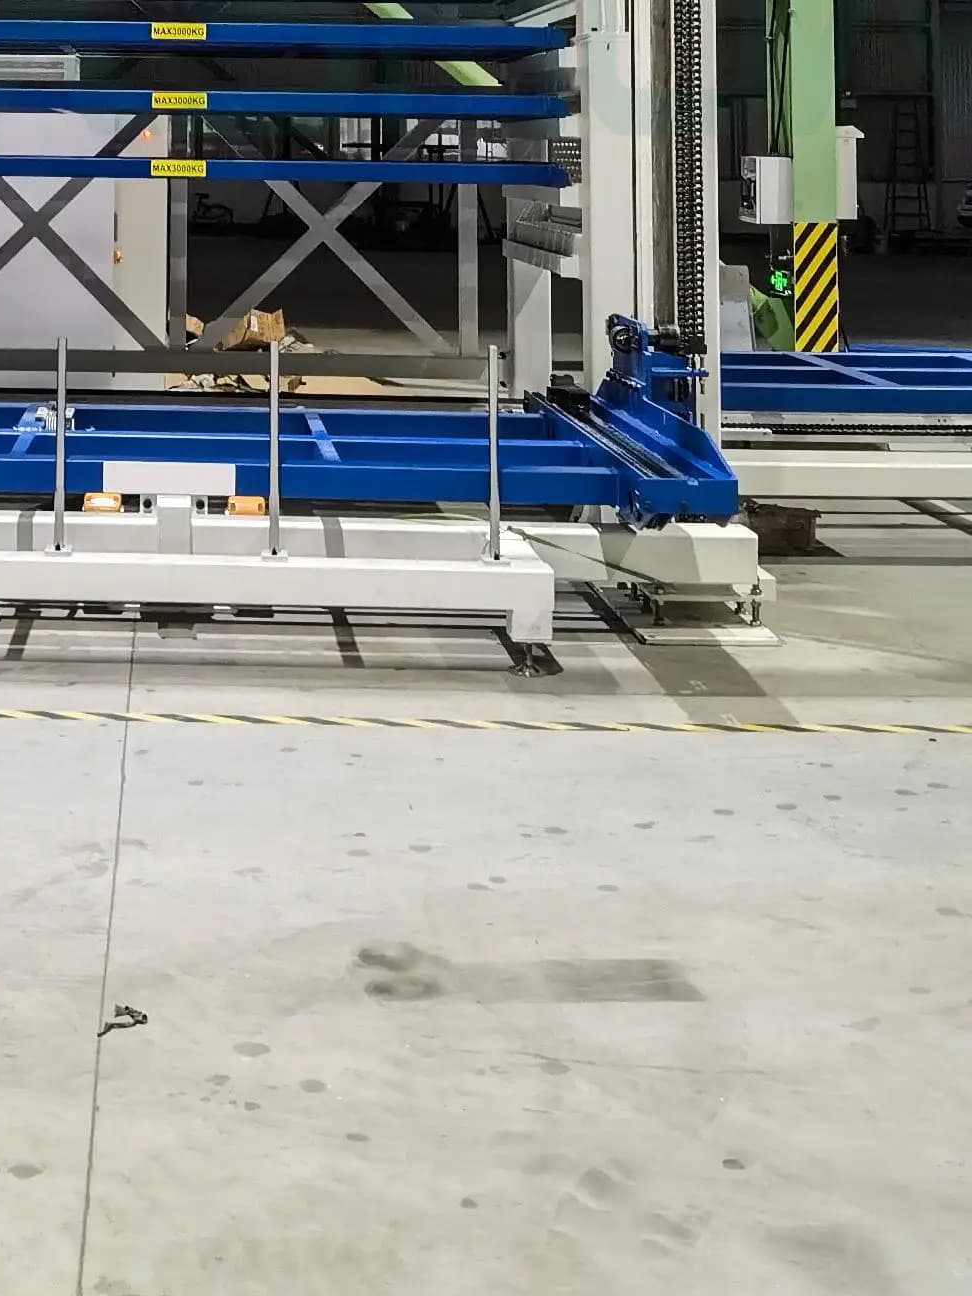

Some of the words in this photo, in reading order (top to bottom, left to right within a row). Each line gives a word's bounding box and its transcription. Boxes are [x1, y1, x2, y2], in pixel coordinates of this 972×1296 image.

[153, 27, 204, 36] MAX3000KG
[154, 96, 205, 105] MAX3000KG
[153, 164, 204, 173] MAX3000KG
